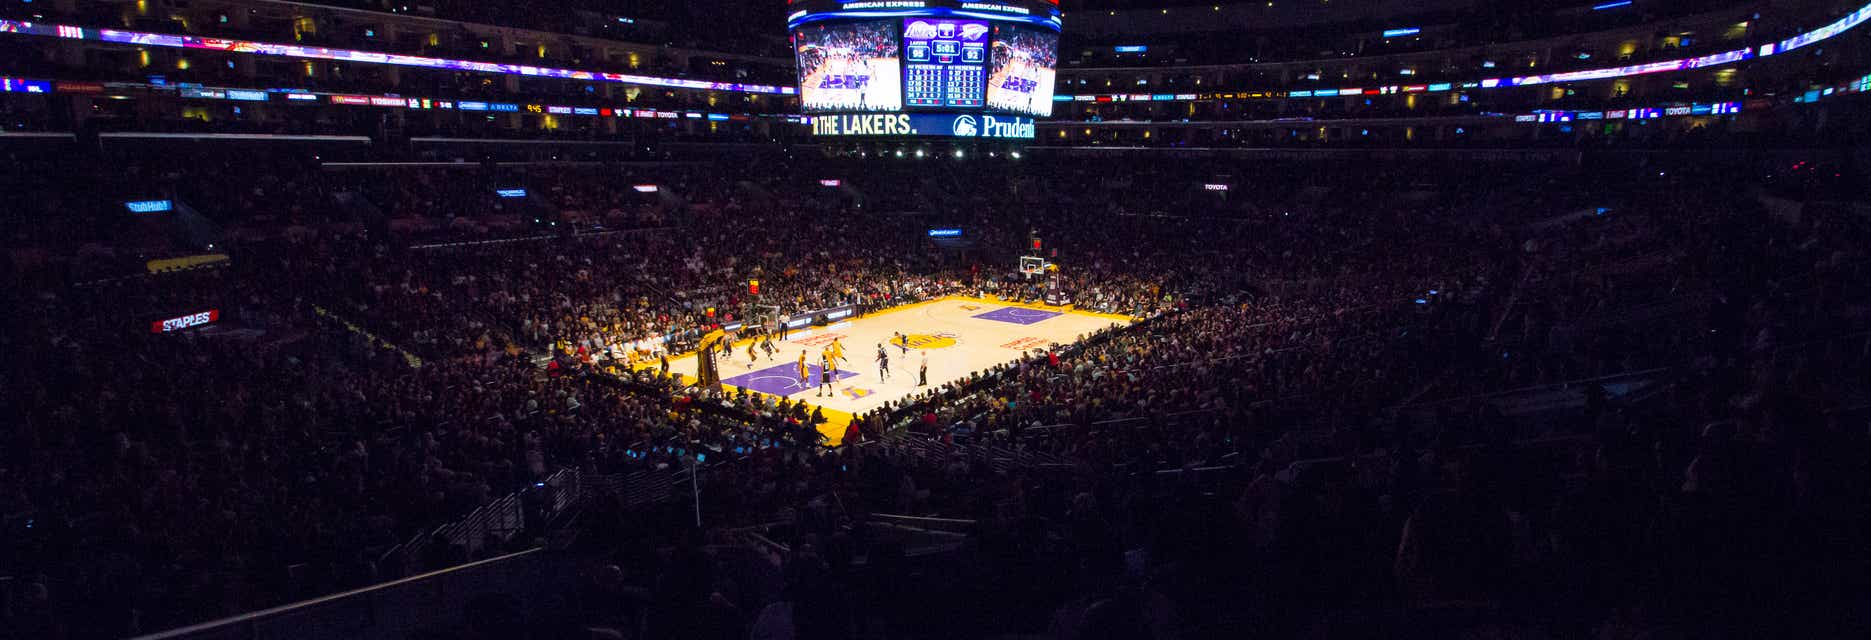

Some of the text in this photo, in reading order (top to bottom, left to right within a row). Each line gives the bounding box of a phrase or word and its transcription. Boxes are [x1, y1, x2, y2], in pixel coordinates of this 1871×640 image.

[962, 3, 1029, 14] AMERICAN EXPRESS
[936, 44, 955, 53] 5:01
[912, 49, 924, 58] 95
[967, 50, 979, 60] 92
[371, 97, 406, 106] TOSHIBA
[497, 104, 518, 112] DELTA
[1666, 107, 1691, 116] TOYOTA
[819, 115, 839, 135] THE
[843, 114, 917, 134] LAKERS.
[1204, 183, 1229, 191] TOYOTA
[163, 312, 211, 331] STAPLES
